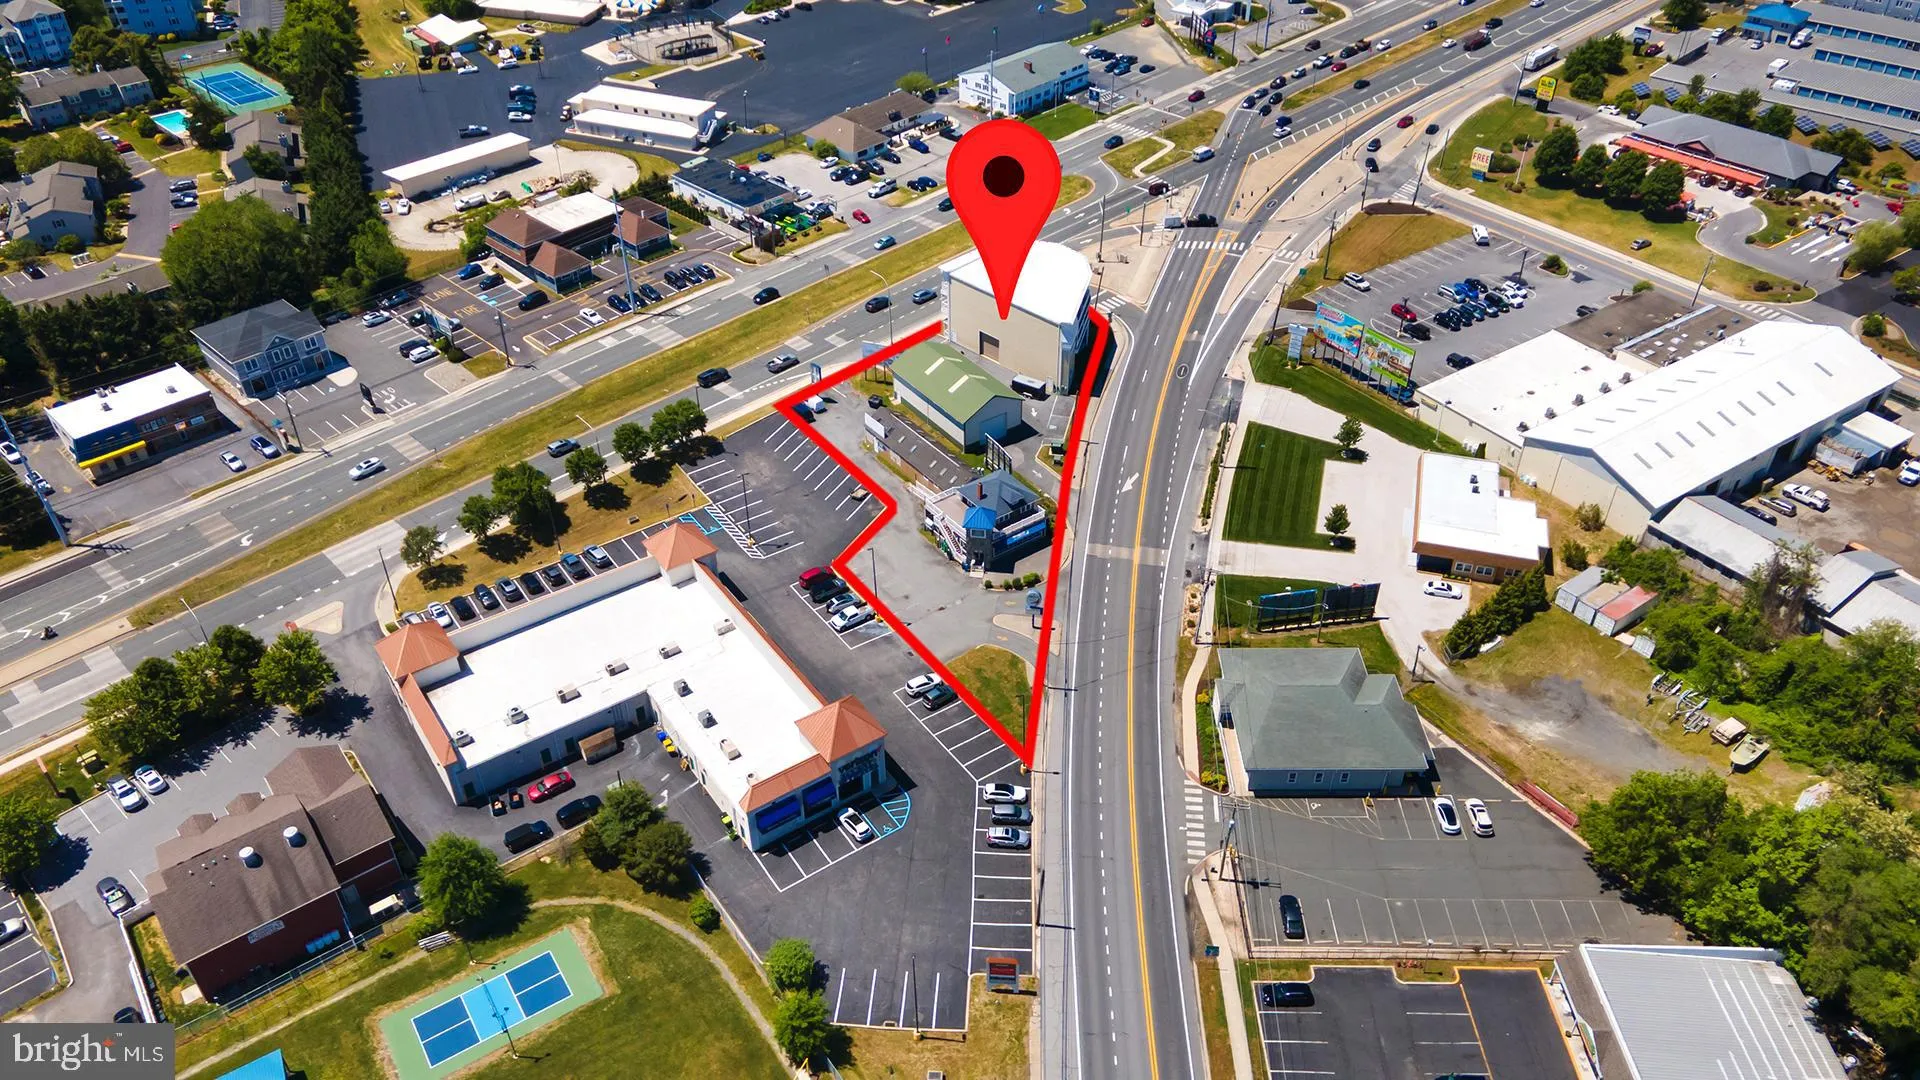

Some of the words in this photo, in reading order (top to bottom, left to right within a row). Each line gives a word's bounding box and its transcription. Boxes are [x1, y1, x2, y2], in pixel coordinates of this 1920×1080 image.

[1472, 152, 1490, 164] FREE
[424, 287, 457, 302] LANE
[454, 304, 485, 319] FIRE
